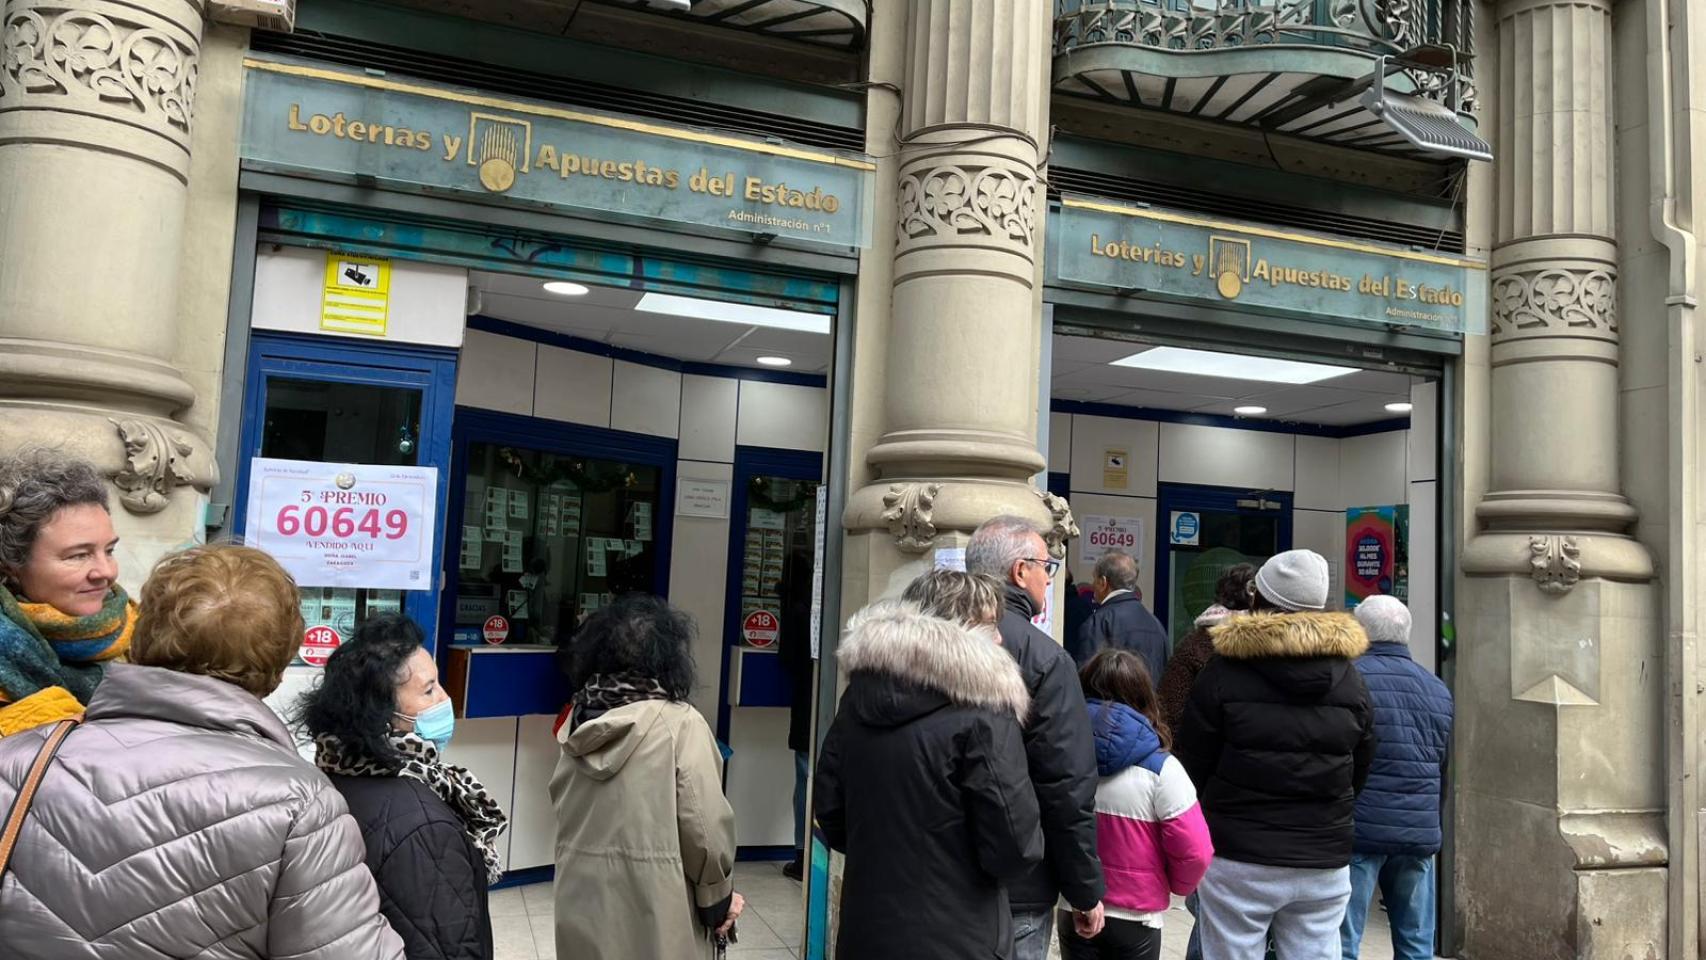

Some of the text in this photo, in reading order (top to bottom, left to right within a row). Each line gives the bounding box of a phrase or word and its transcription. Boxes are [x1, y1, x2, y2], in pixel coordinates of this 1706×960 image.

[442, 133, 462, 161] y
[534, 143, 680, 190] Apuestas
[688, 166, 735, 197] del
[744, 175, 840, 213] Estado
[727, 209, 809, 231] Administración
[1191, 253, 1206, 276] y
[1253, 258, 1351, 292] Apuestas
[1358, 273, 1392, 298] del
[1396, 278, 1464, 307] Estado
[320, 490, 387, 506] PREMIO
[276, 504, 408, 540] 60649
[305, 540, 349, 550] VENDIDO
[1090, 532, 1135, 547] 60649
[752, 614, 770, 627] +18
[308, 630, 332, 643] +18
